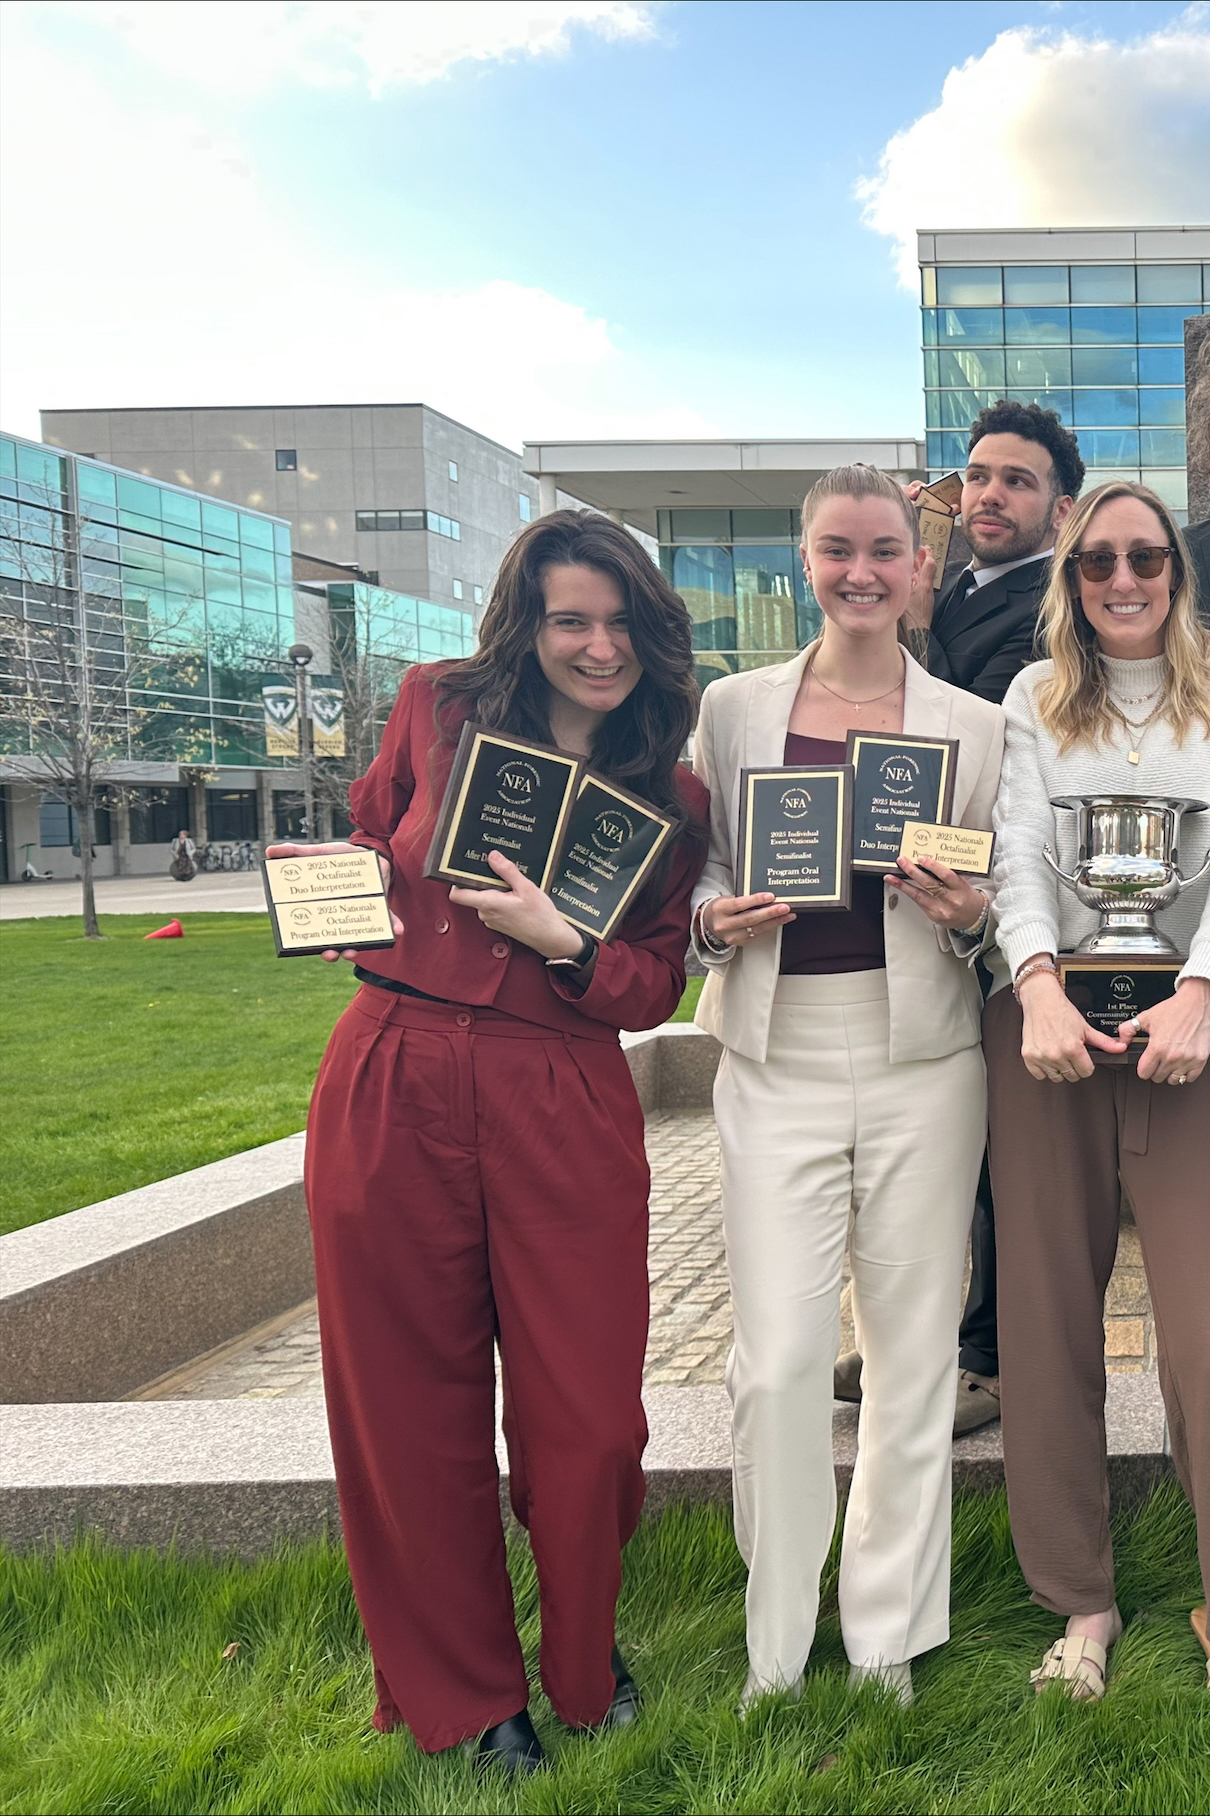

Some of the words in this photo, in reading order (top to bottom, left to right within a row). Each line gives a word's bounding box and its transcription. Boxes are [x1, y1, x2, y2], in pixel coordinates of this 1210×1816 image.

[879, 755, 901, 772] NATIONAL
[886, 767, 912, 782] NFA
[502, 772, 531, 793] NFA
[785, 798, 806, 808] NFA
[889, 799, 920, 808] Individual
[483, 804, 500, 814] 2025
[502, 808, 536, 824] Individual
[890, 808, 919, 816] Nationals
[480, 813, 500, 825] Event
[501, 818, 533, 833] Nationals
[875, 823, 902, 832] Semifina
[597, 819, 624, 843] NFA
[482, 833, 521, 850] Semifinalist
[860, 840, 876, 849] Duo
[936, 832, 952, 841] 2025
[954, 834, 984, 845] Nationals
[465, 849, 480, 861] After
[940, 843, 976, 855] Octafinalist
[573, 843, 589, 855] 2025
[589, 852, 619, 873] Individual
[776, 852, 812, 860] Semifinalist
[935, 854, 979, 866] Interpretation
[307, 861, 328, 870] 2025
[330, 858, 366, 868] Nationals
[568, 851, 586, 865] Event
[586, 860, 613, 880] Nationals
[317, 870, 361, 880] Octafinalist
[767, 868, 799, 876] Program
[290, 886, 308, 894] Duo
[311, 881, 365, 892] Interpretation
[564, 869, 599, 894] Semifinalist
[768, 878, 820, 886] Interpretation
[558, 888, 600, 917] Interpretation
[317, 906, 337, 915] 2025
[340, 903, 376, 912] Nationals
[327, 915, 371, 925] Octafinalist
[290, 931, 320, 940] Program
[322, 928, 337, 937] Oral
[339, 925, 384, 936] Interpretation
[1114, 983, 1131, 992] NFA
